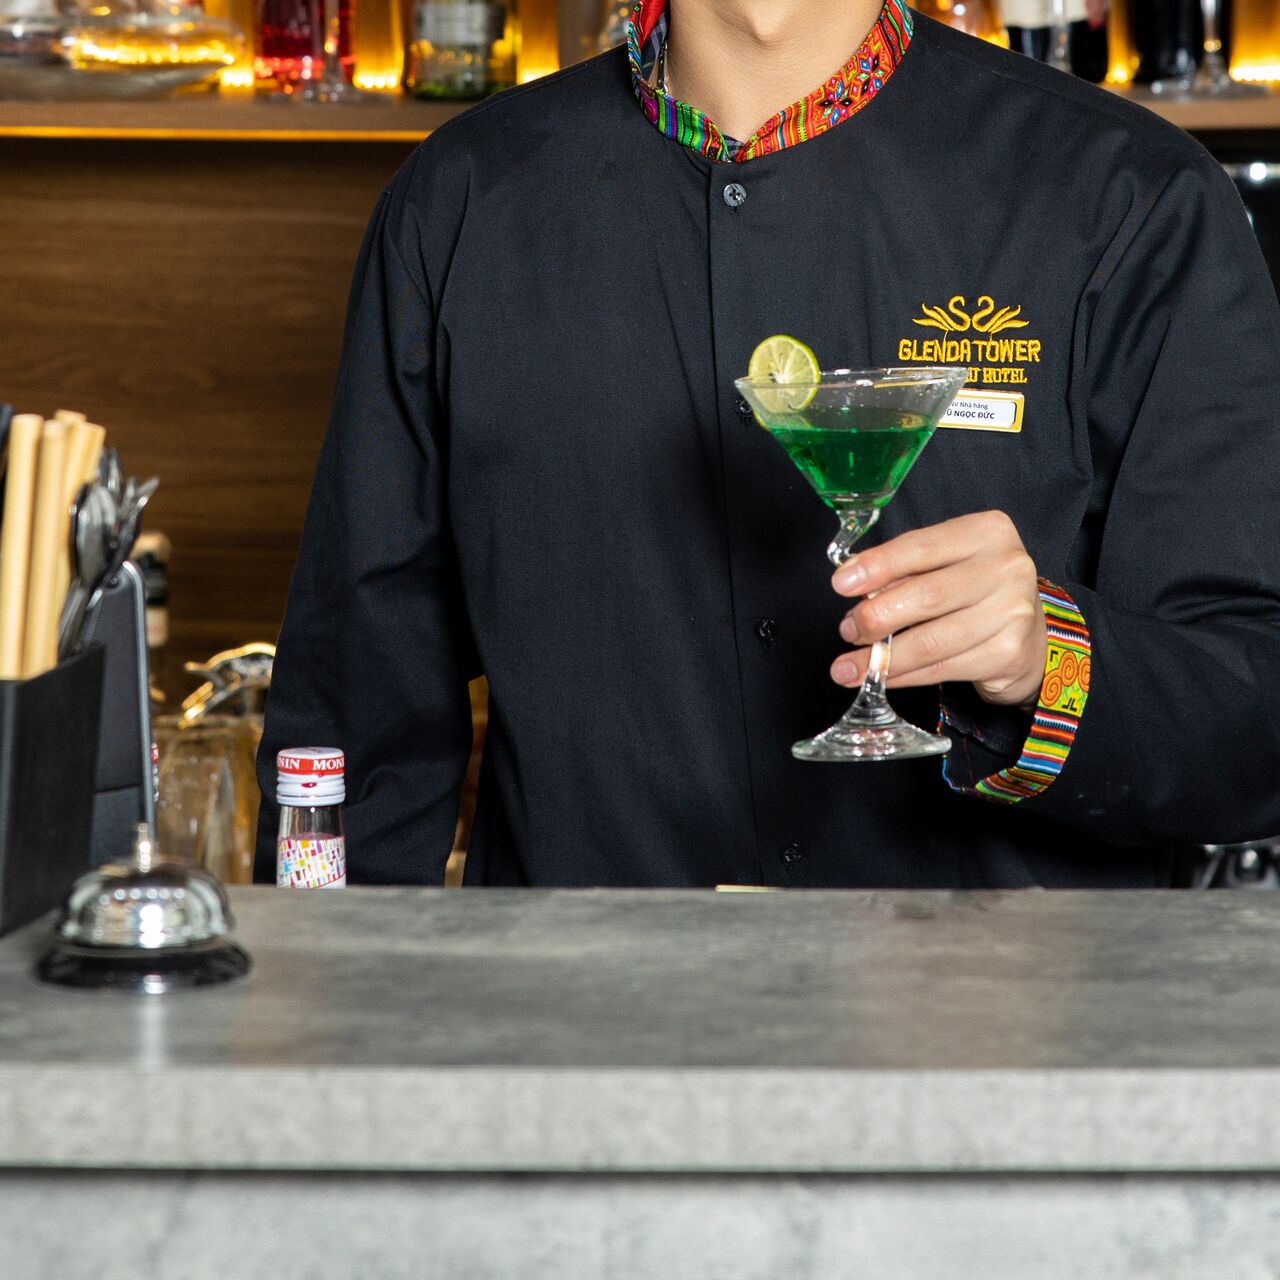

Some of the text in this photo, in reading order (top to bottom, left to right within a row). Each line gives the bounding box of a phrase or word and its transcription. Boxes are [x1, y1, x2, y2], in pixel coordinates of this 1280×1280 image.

[898, 338, 1041, 363] GLENDA TOWER
[982, 367, 1028, 384] HOTEL
[973, 402, 988, 410] hàng
[954, 410, 976, 419] NGỌC
[978, 410, 995, 419] ĐỨC
